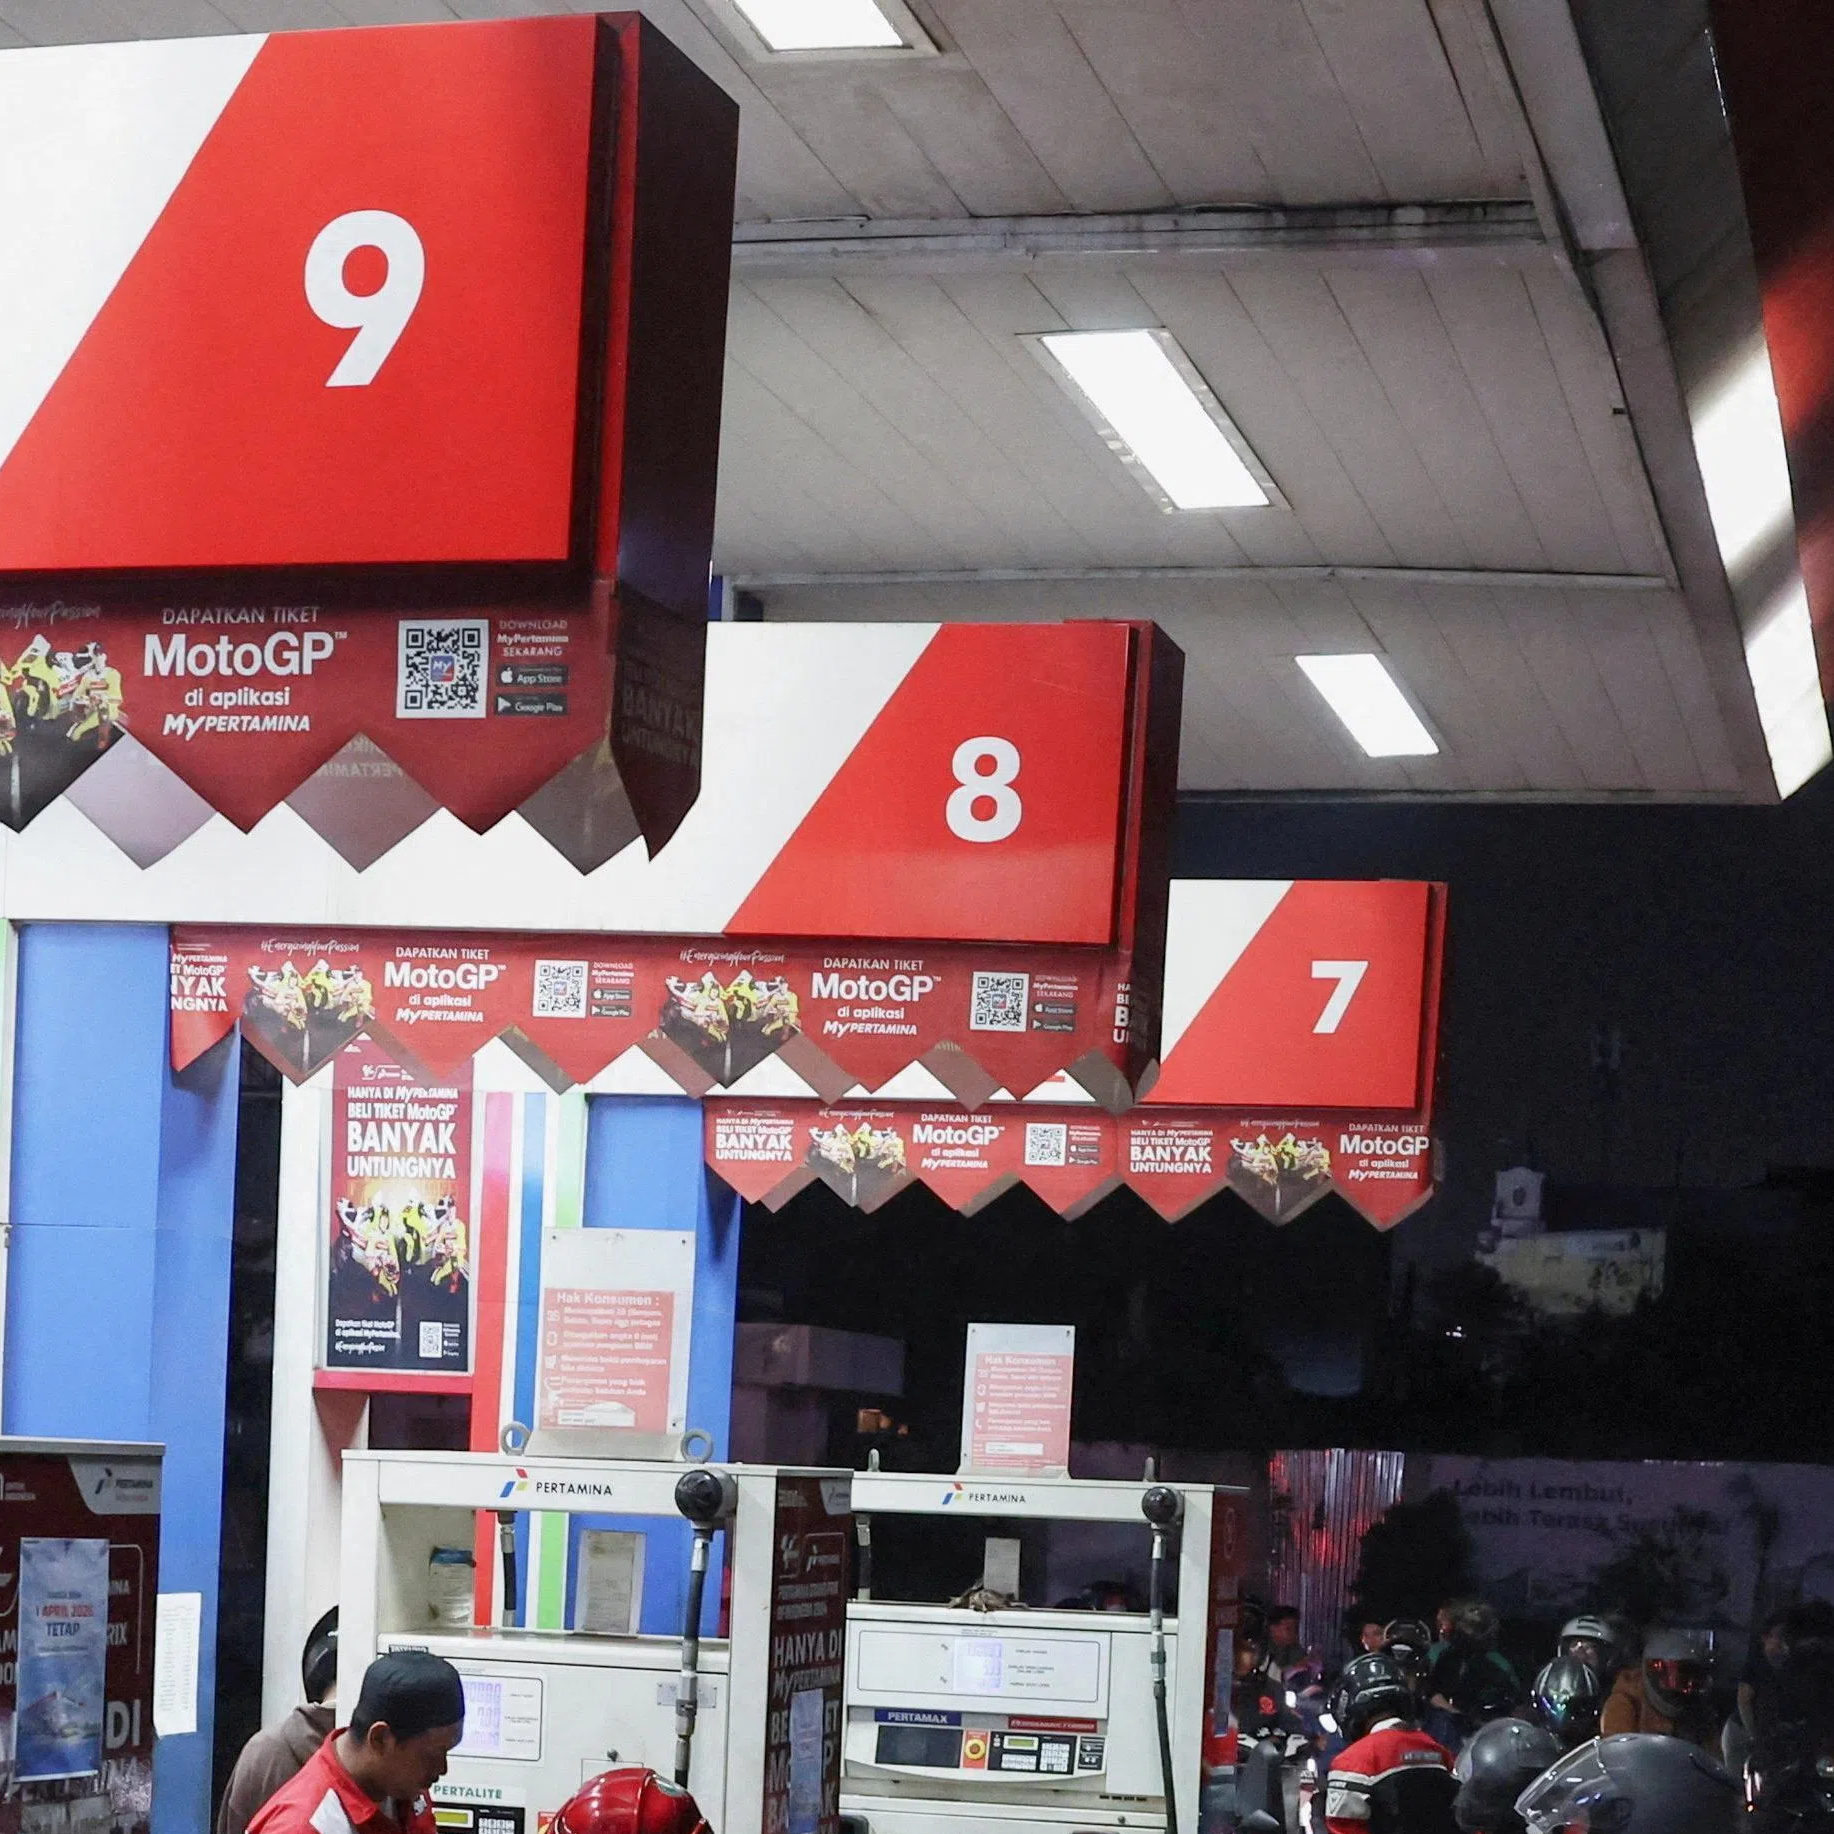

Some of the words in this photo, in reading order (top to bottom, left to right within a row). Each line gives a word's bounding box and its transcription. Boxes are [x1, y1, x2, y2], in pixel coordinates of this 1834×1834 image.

[304, 207, 427, 389] 9
[161, 606, 265, 626] DAPATKAN
[272, 605, 321, 624] TIKET
[499, 619, 568, 630] DOWNLOAD
[502, 646, 562, 658] SEKARANG
[517, 674, 537, 686] App
[537, 673, 562, 684] Store
[185, 686, 203, 707] di
[209, 686, 290, 709] aplikasi
[515, 702, 544, 715] Google
[163, 713, 311, 741] MyPERTAMINA
[946, 736, 1023, 843] 8
[395, 946, 457, 958] DAPATKAN
[460, 948, 490, 960] TIKET
[823, 957, 889, 971] DAPATKAN
[893, 959, 924, 972] TIKET
[408, 994, 420, 1006] di
[422, 994, 471, 1008] aplikasi
[1310, 960, 1369, 1034] 7
[396, 1007, 484, 1025] MyPERTAMINA
[837, 1006, 849, 1018] di
[853, 1006, 905, 1021] aplikasi
[823, 1020, 918, 1039] MyPERTAMINA
[347, 1086, 381, 1100] HANYA
[348, 1102, 372, 1119] BELI
[374, 1102, 405, 1119] TIKET
[347, 1120, 456, 1154] BANYAK
[715, 1134, 793, 1150] BANYAK
[715, 1149, 793, 1162] UNTUNGNYA
[942, 1148, 980, 1159] aplikasi
[1130, 1146, 1213, 1162] BANYAK
[347, 1156, 456, 1180] UNTUNGNYA
[921, 1157, 989, 1170] MyPERTAMINA
[1130, 1161, 1213, 1175] UNTUNGNYA
[1371, 1159, 1409, 1170] aplikasi
[1349, 1169, 1418, 1182] MyPERTAMINA
[556, 1292, 581, 1304] Hak
[584, 1293, 652, 1306] Konsumen
[536, 1482, 613, 1497] PERTAMINA
[1454, 1479, 1521, 1499] Lebih
[968, 1493, 1026, 1504] PERTAMINA
[46, 1622, 80, 1638] TETAP
[774, 1631, 825, 1668] HANYA
[828, 1628, 843, 1658] DI
[106, 1698, 141, 1750] DI
[887, 1711, 948, 1724] PERTAMAX
[433, 1784, 503, 1800] PERTALITE
